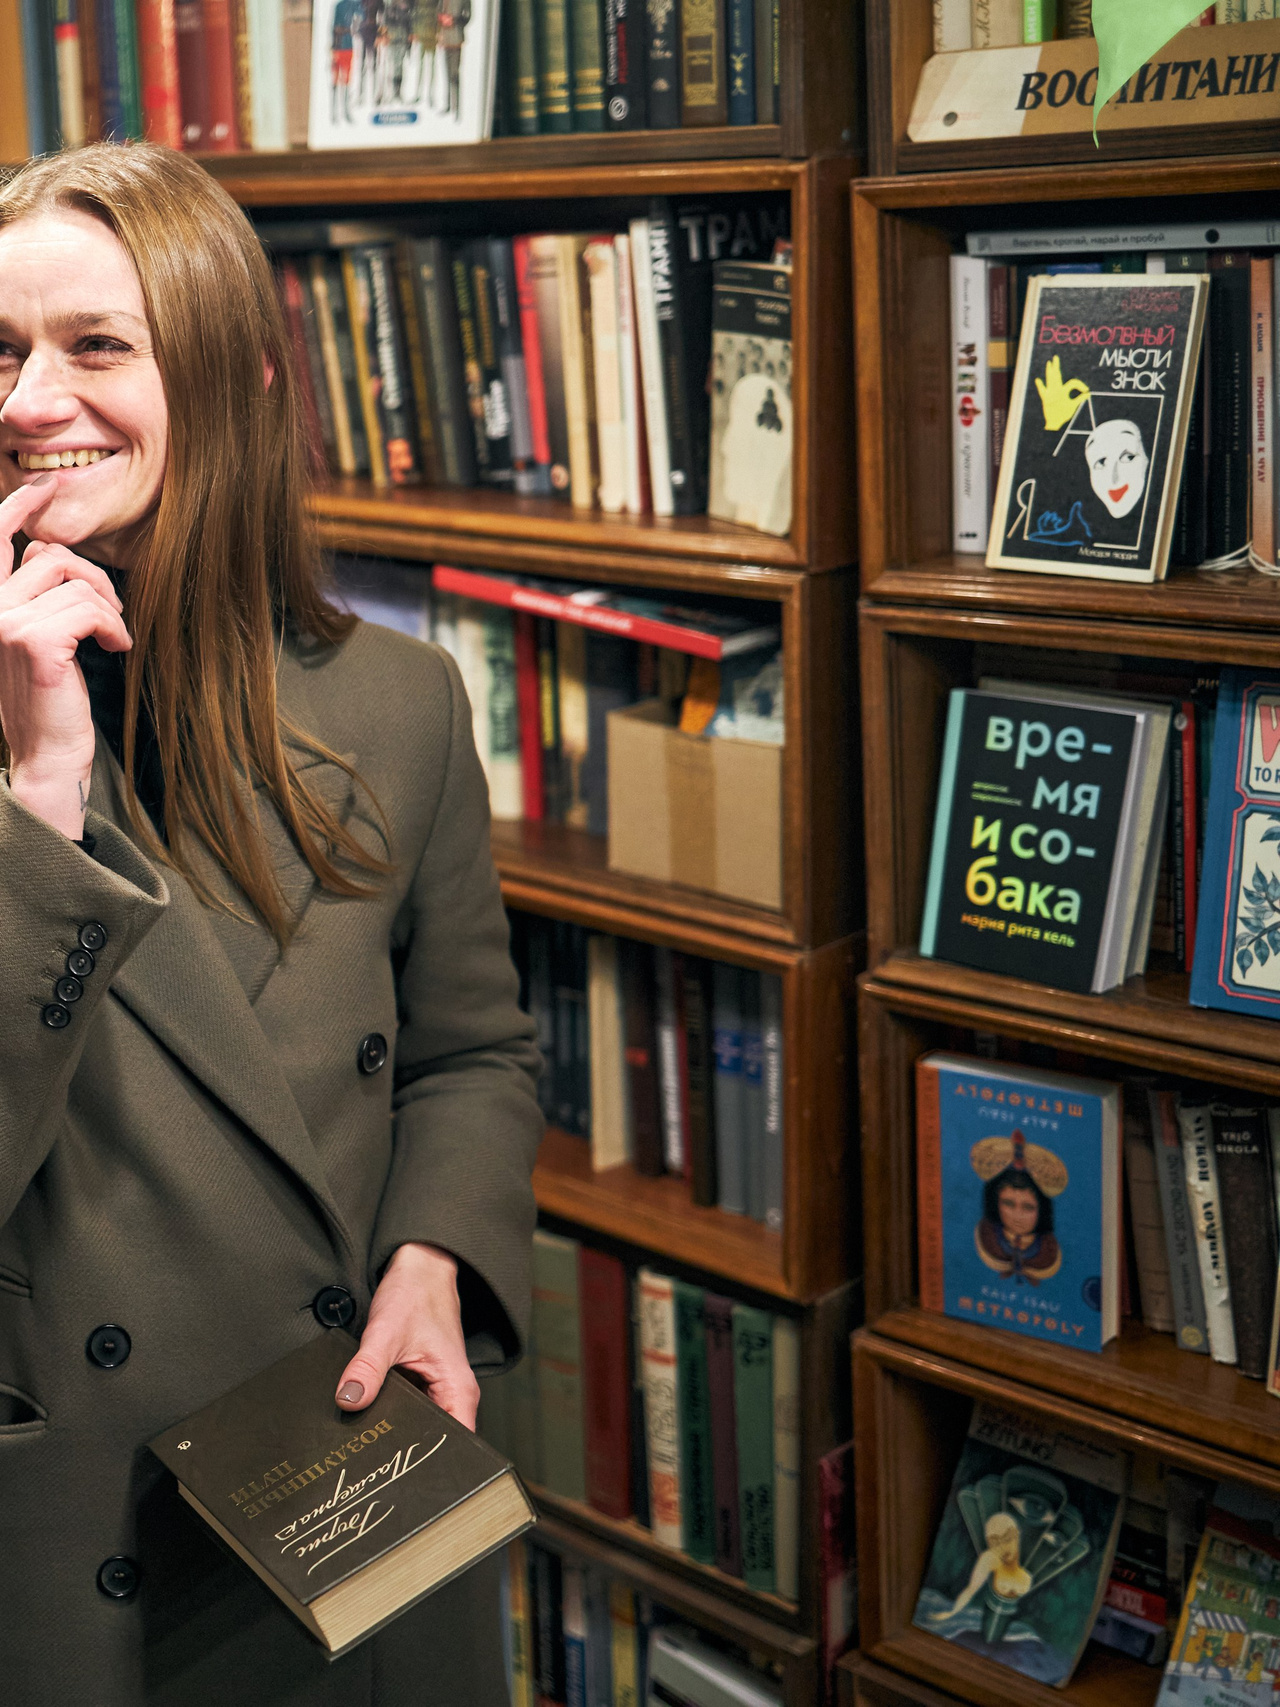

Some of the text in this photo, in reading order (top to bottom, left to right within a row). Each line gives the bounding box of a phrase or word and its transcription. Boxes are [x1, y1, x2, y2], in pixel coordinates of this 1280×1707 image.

[1129, 233, 1165, 244] пробуй
[1039, 315, 1176, 346] Безмолвный
[1255, 377, 1266, 442] ПРИОБЩЕНИЕ
[1256, 457, 1265, 483] ЧУДУ
[985, 715, 1112, 770] вре-
[1032, 776, 1101, 819] мя
[971, 815, 1096, 864] и со-
[966, 855, 1081, 925] бака
[961, 913, 1076, 948] мария рита кель
[954, 1085, 1084, 1118] METROPOLY
[957, 1296, 1086, 1338] METROPOLY
[227, 1459, 297, 1507] ПУТИ
[242, 1419, 394, 1519] ВОЗДУШНЫЕ
[274, 1433, 447, 1554] Пастернак
[294, 1500, 394, 1576] Борис
